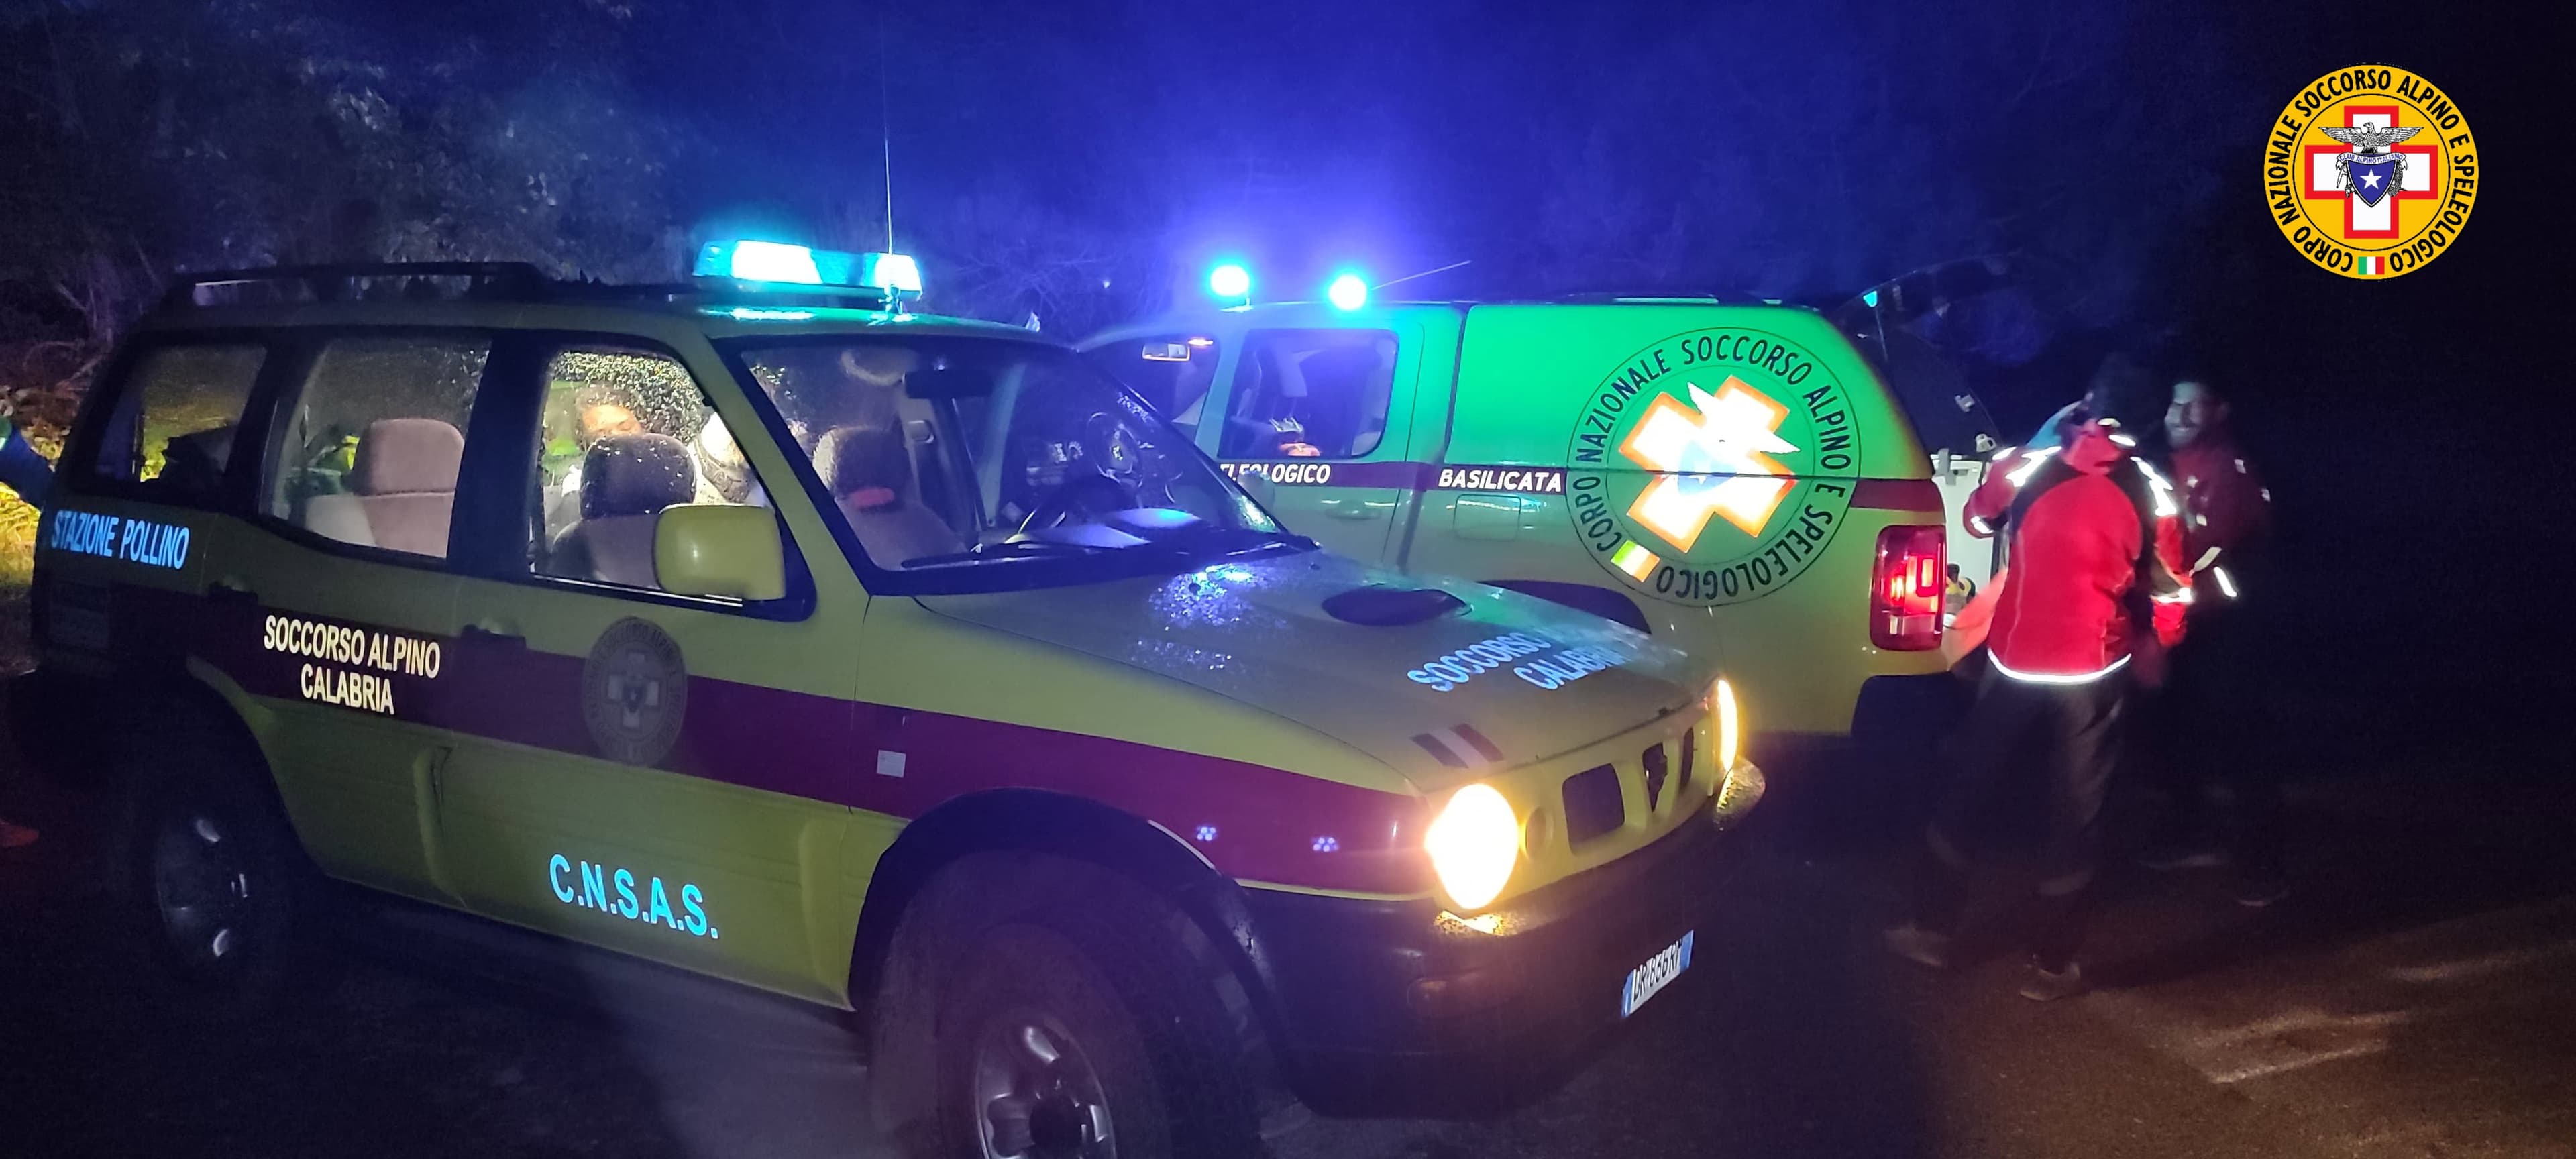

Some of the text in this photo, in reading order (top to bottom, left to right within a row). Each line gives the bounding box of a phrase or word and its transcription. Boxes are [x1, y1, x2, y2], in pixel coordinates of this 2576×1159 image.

[1438, 469, 1562, 493] BASILICATA
[1574, 334, 1853, 600] CORPO NAZIONALE SOCCORSO ALPINO E SPELEOLOGICO
[51, 510, 190, 569] STAZIONE POLLINO
[264, 614, 440, 679] SOCCORSO ALPINO
[301, 664, 395, 715] CALABRIA
[549, 854, 719, 939] C.N.S.A.S.
